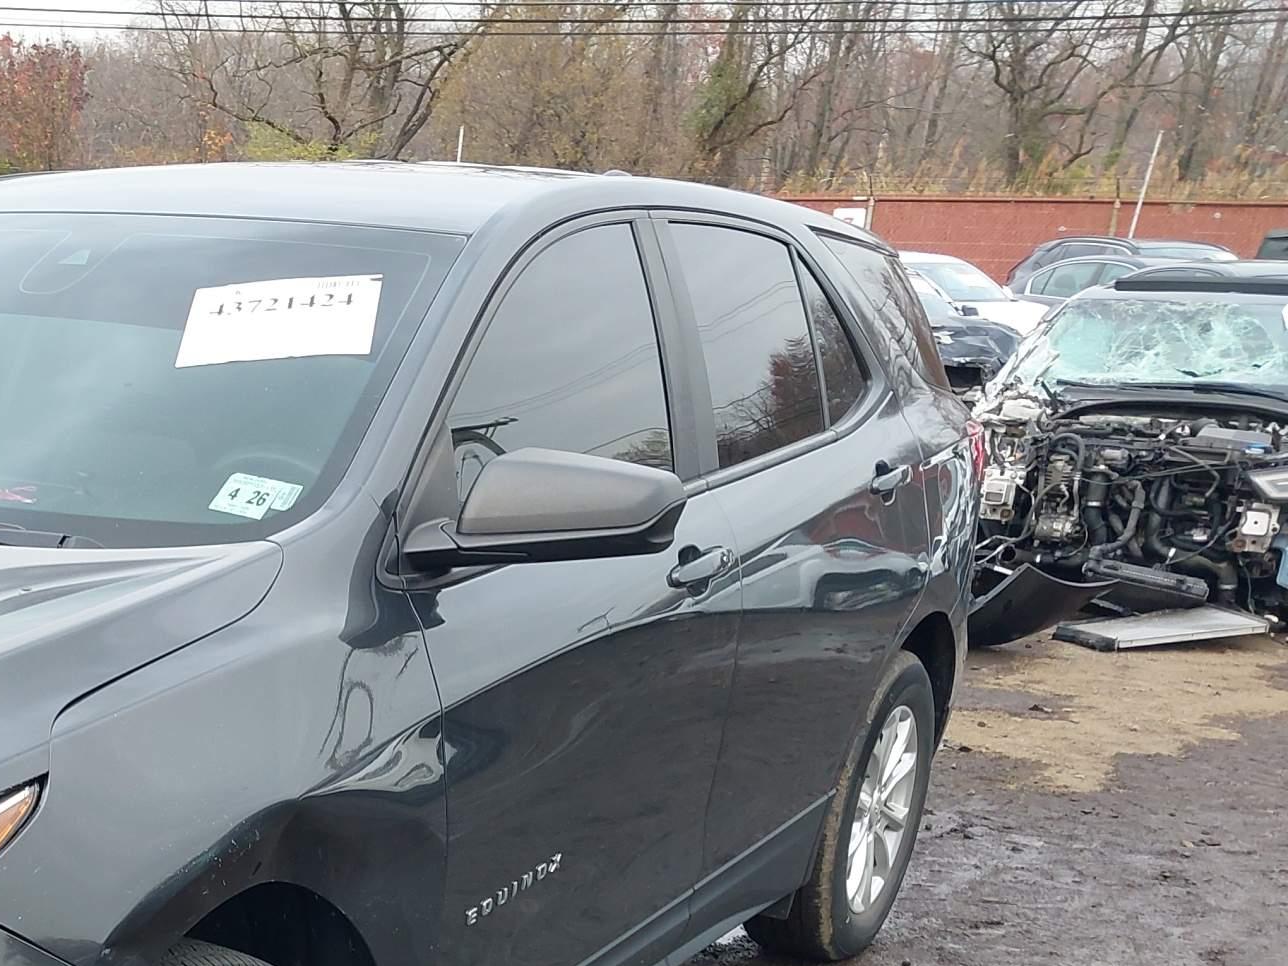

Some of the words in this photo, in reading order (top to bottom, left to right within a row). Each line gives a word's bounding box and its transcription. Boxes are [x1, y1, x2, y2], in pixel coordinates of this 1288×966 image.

[209, 292, 353, 316] 43721424
[228, 487, 241, 500] 4
[245, 490, 270, 506] 26
[465, 852, 563, 926] EQUINOX
